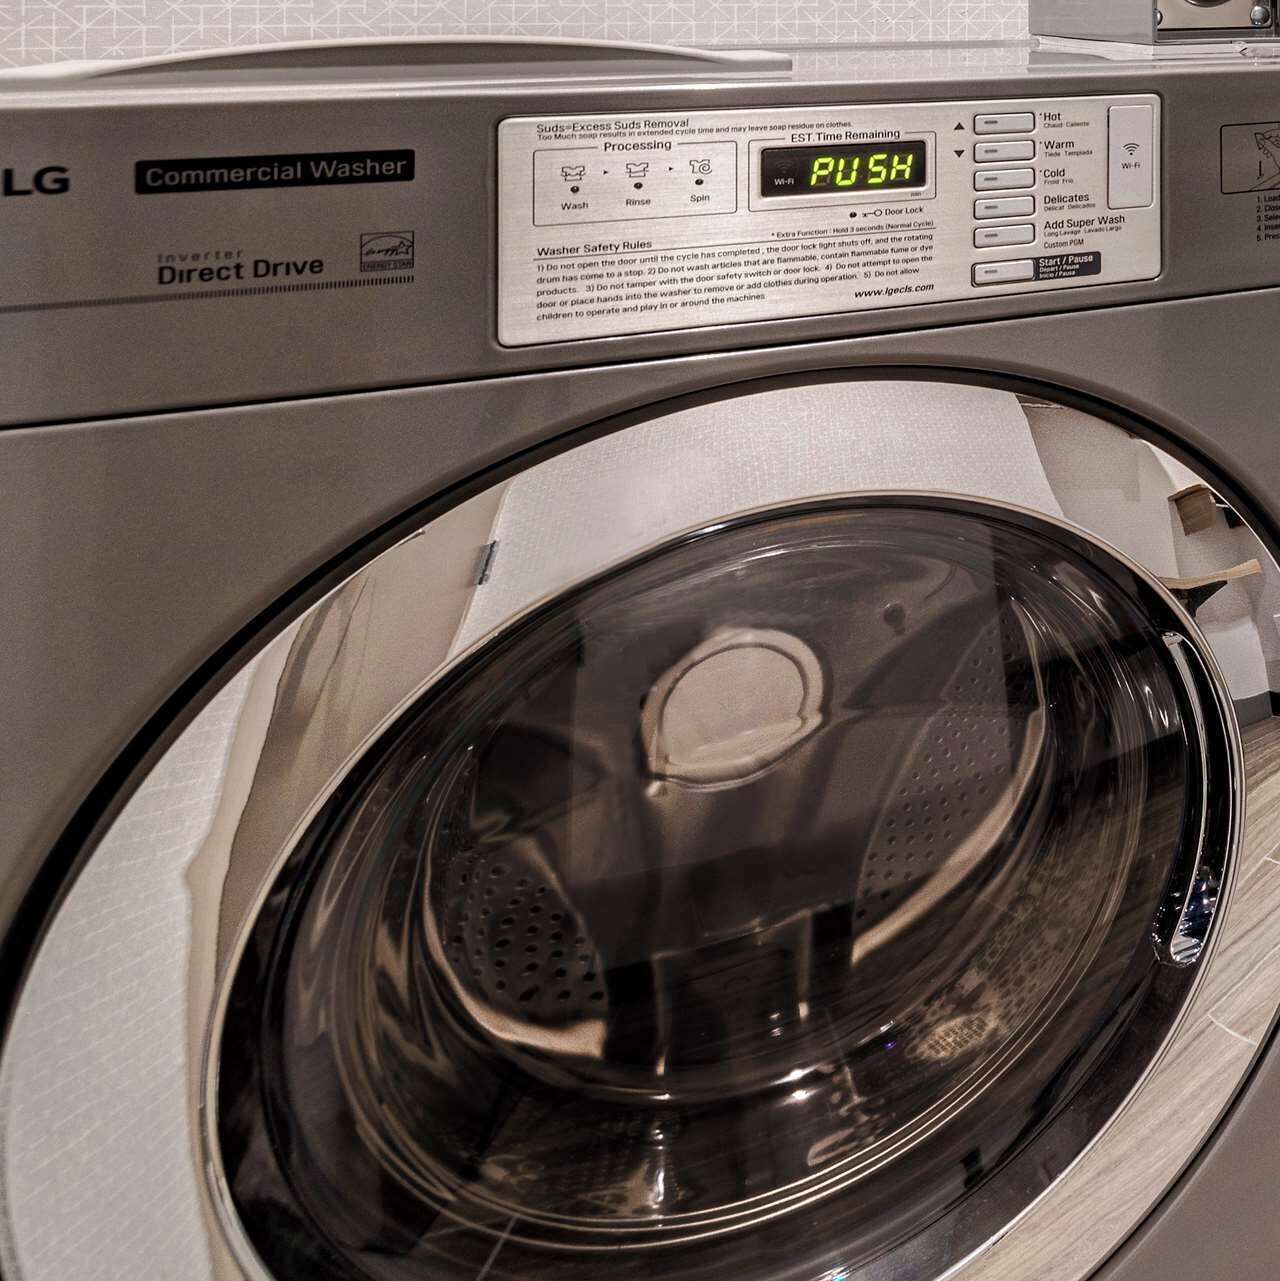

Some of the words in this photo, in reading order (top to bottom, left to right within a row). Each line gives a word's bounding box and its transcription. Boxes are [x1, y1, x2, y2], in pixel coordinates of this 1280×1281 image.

[614, 120, 641, 130] Suds
[643, 118, 688, 128] Removal
[845, 129, 900, 140] Remaining
[604, 140, 672, 152] Processing
[145, 162, 301, 188] Commercial
[310, 157, 407, 180] Washer
[810, 153, 913, 186] PUSH
[1121, 162, 1140, 170] Wi-Fi
[2, 165, 71, 198] LG
[625, 198, 651, 207] Rinse
[690, 194, 710, 203] Spin
[1043, 193, 1090, 205] Delicates
[561, 202, 589, 211] Wash
[884, 207, 903, 216] Door
[905, 206, 923, 215] Lock
[1043, 219, 1064, 231] Add
[1066, 218, 1095, 229] Super
[1097, 215, 1125, 225] Wash
[537, 245, 580, 256] Washer
[583, 242, 621, 254] Safety
[622, 240, 653, 250] Rules
[1043, 239, 1069, 249] Custom
[546, 263, 558, 271] Do
[560, 262, 575, 270] not
[577, 261, 599, 270] open
[601, 259, 615, 267] the
[639, 255, 658, 264] until
[660, 254, 674, 262] the
[676, 251, 699, 262] cycle
[700, 251, 715, 259] has
[781, 244, 799, 252] door
[800, 242, 817, 250] lock
[818, 241, 836, 250] light
[837, 239, 858, 247] shuts
[874, 236, 888, 244] and
[903, 233, 933, 241] rotating
[536, 276, 560, 284] drum
[579, 272, 604, 280] come
[657, 266, 669, 274] Do
[670, 265, 684, 273] not
[686, 263, 709, 272] wash
[711, 260, 741, 269] articles
[743, 258, 760, 267] that
[761, 257, 775, 265] are
[820, 251, 849, 260] contain
[850, 247, 889, 257] flammable
[919, 244, 933, 252] dye
[1039, 258, 1060, 267] Start
[1068, 254, 1093, 263] Pause
[157, 261, 244, 286] Direct
[253, 256, 325, 280] Drive
[596, 283, 608, 291] Do
[609, 282, 624, 290] not
[626, 279, 657, 288] tamper
[658, 277, 678, 286] with
[679, 276, 694, 284] the
[695, 274, 714, 282] door
[716, 271, 742, 280] safety
[743, 268, 771, 278] switch
[835, 262, 846, 270] Do
[847, 261, 860, 269] not
[861, 258, 891, 267] attempt
[901, 256, 919, 264] open
[854, 283, 934, 299] www.lgecls.com
